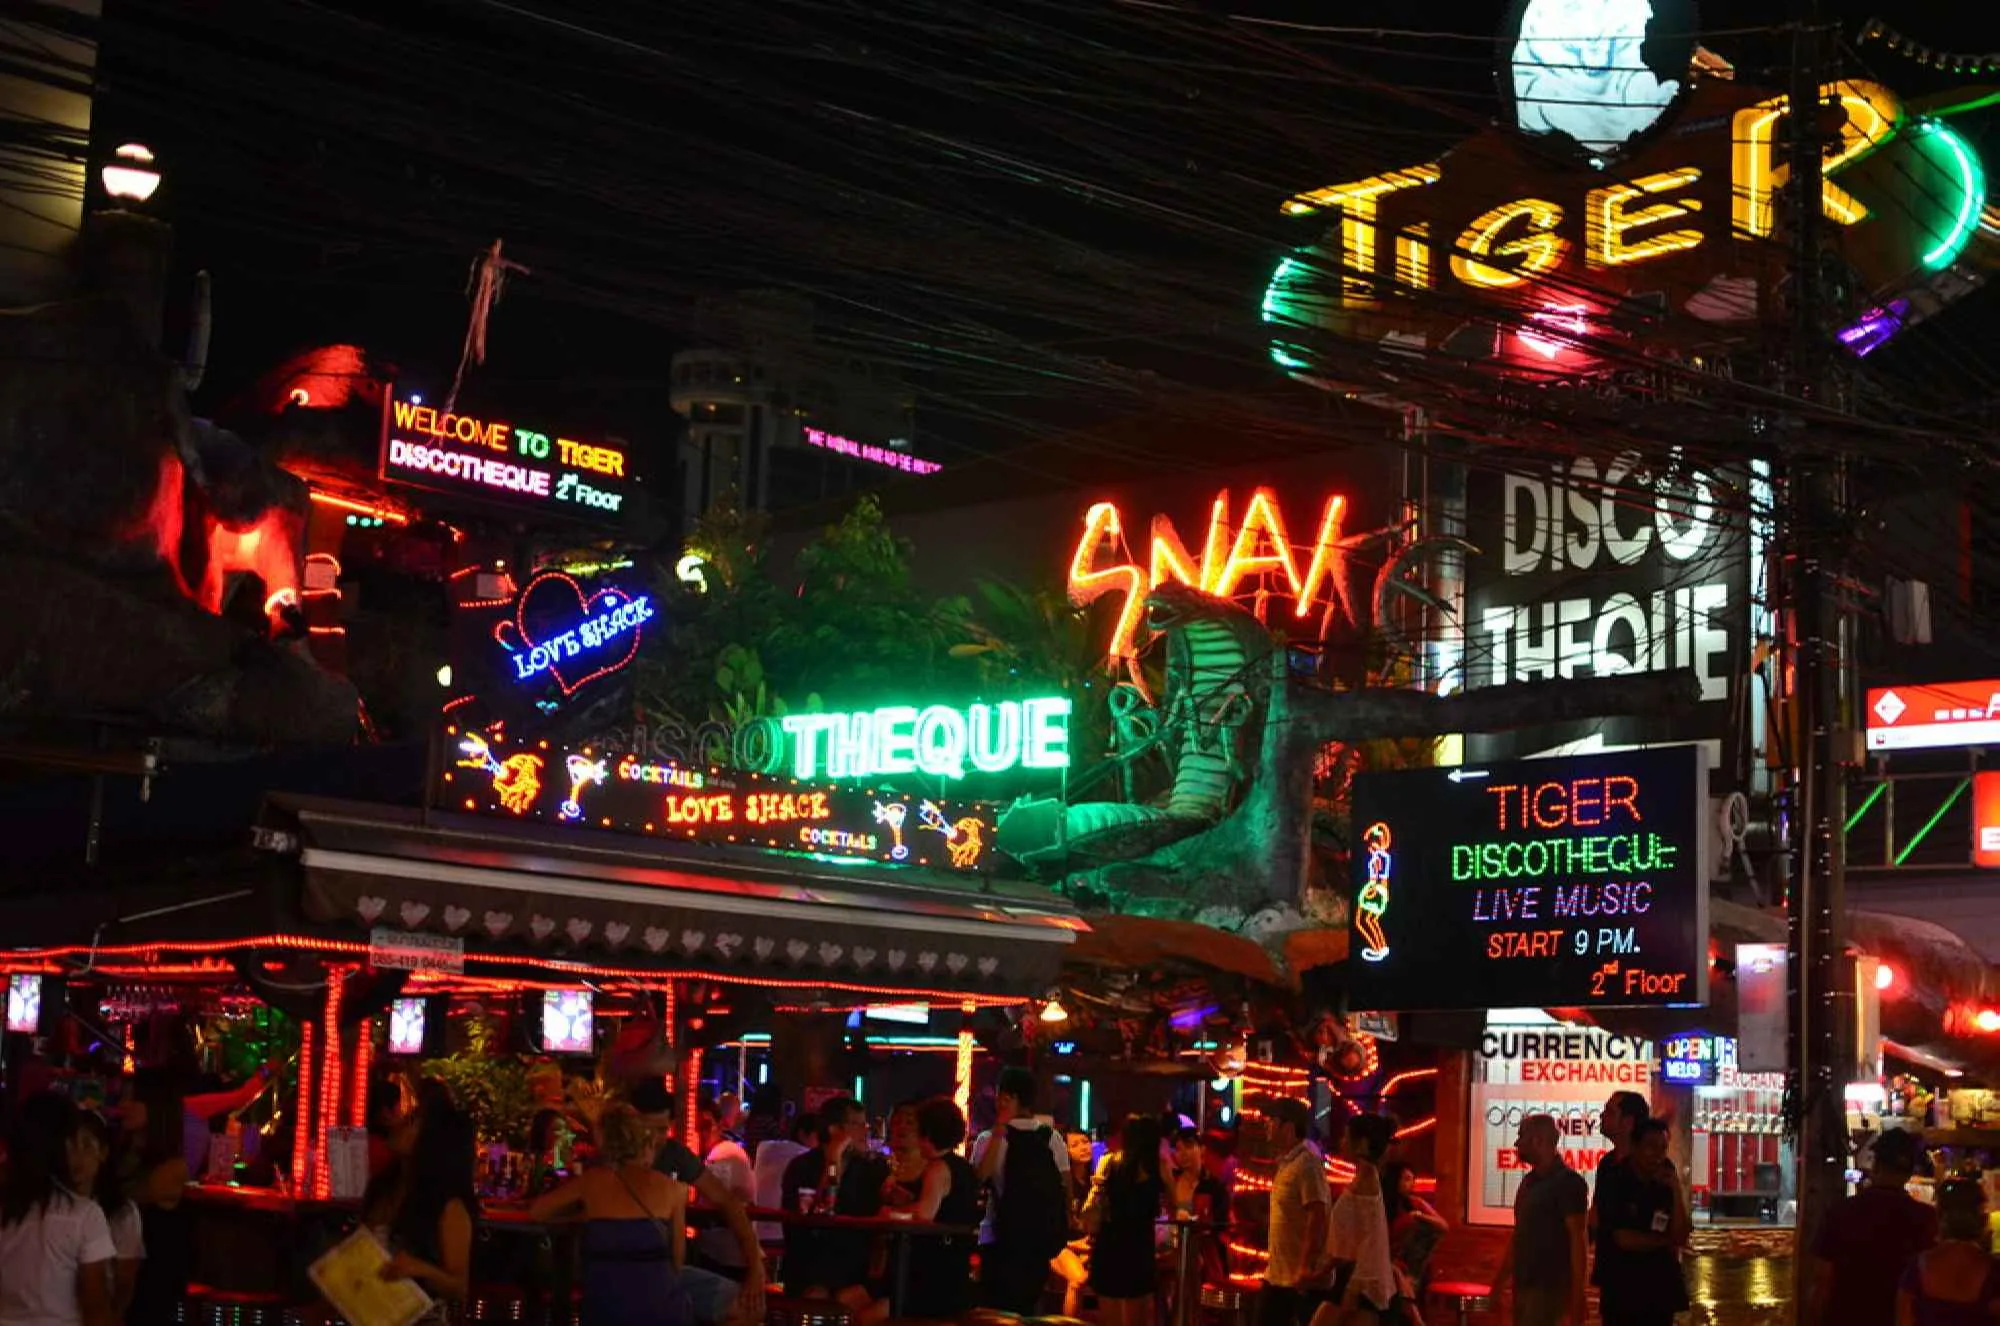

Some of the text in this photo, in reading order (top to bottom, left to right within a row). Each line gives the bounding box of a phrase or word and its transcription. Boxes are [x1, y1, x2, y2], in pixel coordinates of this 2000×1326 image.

[1280, 79, 1900, 308] TIGER
[394, 401, 625, 477] WELCOME TO TIGER
[389, 439, 551, 496] DISCOTHEQUE
[576, 484, 623, 512] Floor
[1504, 446, 1715, 575] DISCO
[514, 596, 654, 679] LOVE SHACK
[1482, 584, 1729, 700] THEQUE
[618, 761, 705, 788] COCKTAILS
[666, 791, 830, 825] LOVE SHACK
[1487, 776, 1642, 831] TIGER
[800, 827, 878, 851] COCKTAILS
[1473, 882, 1652, 921] LIVE MUSIC
[1488, 927, 1641, 959] START 9 PM.
[1624, 970, 1687, 995] Floor
[1480, 1033, 1647, 1060] CURRENCY
[1520, 1061, 1649, 1084] EXCHANGE
